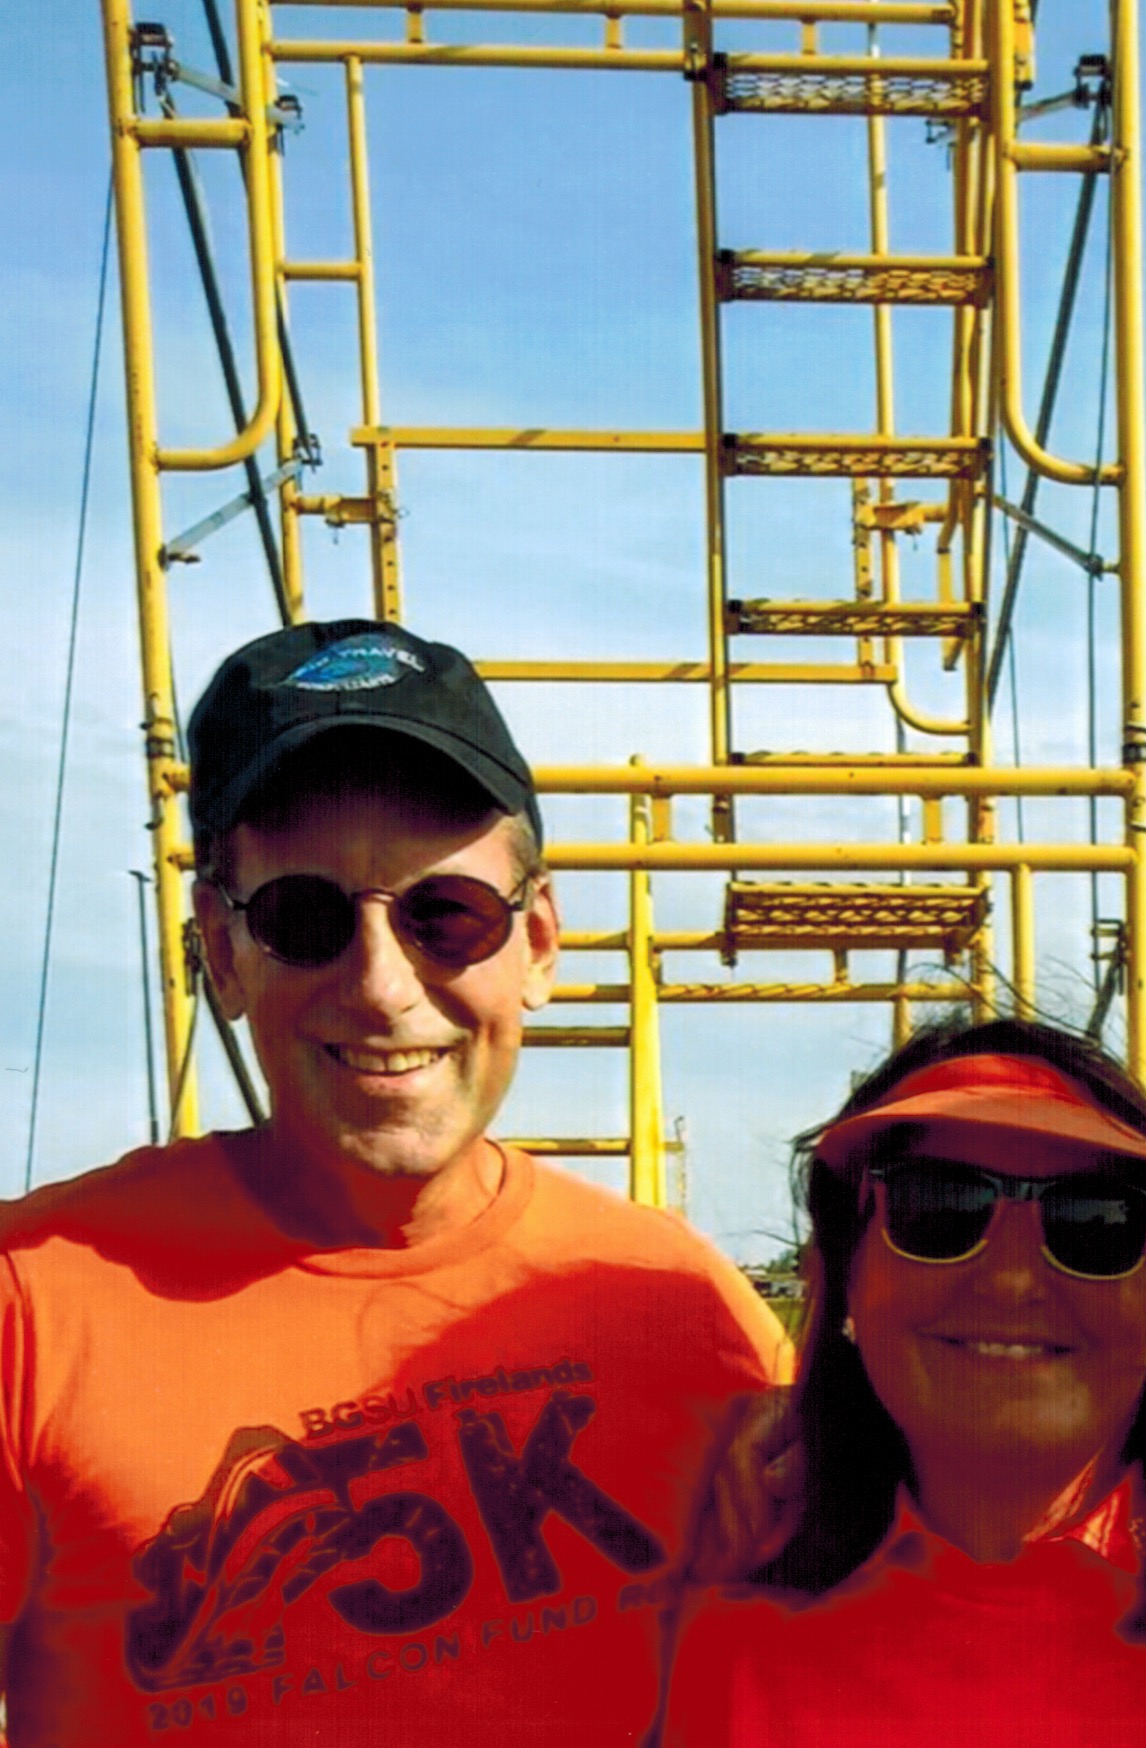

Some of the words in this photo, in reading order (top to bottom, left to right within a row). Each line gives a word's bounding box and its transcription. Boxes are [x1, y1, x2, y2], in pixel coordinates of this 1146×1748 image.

[299, 1389, 417, 1440] BGSU
[423, 1357, 594, 1408] Firelands
[327, 1391, 667, 1635] 5K
[149, 1687, 246, 1730] 2019
[273, 1632, 460, 1704] FALCON
[481, 1595, 597, 1647] FUND
